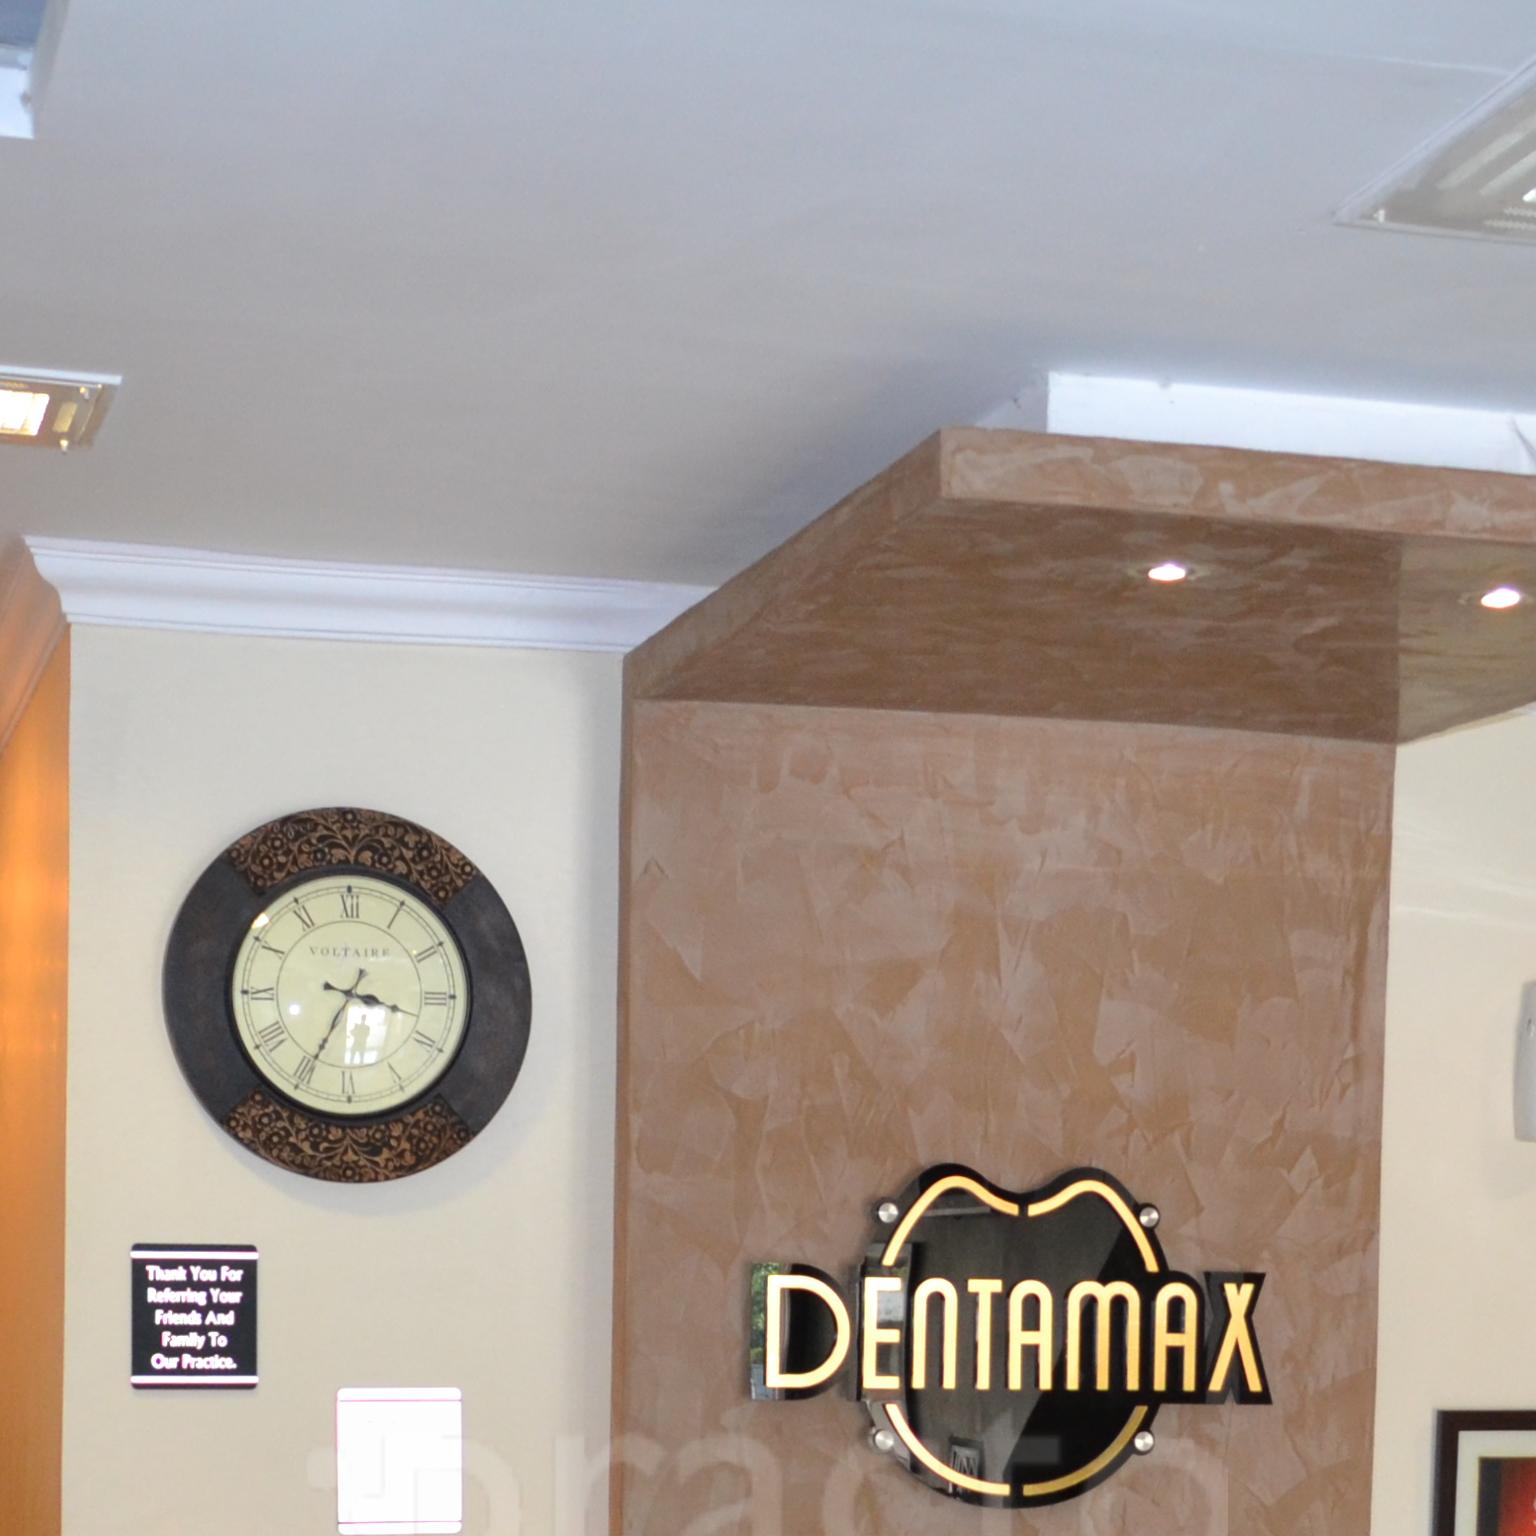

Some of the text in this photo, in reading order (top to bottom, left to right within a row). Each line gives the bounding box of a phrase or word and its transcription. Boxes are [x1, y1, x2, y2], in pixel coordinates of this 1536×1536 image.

[309, 946, 391, 958] VOLTAIRE
[145, 1264, 244, 1282] Thank You For
[146, 1286, 243, 1307] Referring Your
[154, 1308, 235, 1326] Friends And
[160, 1330, 229, 1350] Family To
[762, 1272, 1266, 1394] DENTAMAX
[150, 1352, 238, 1370] Our Practice.
